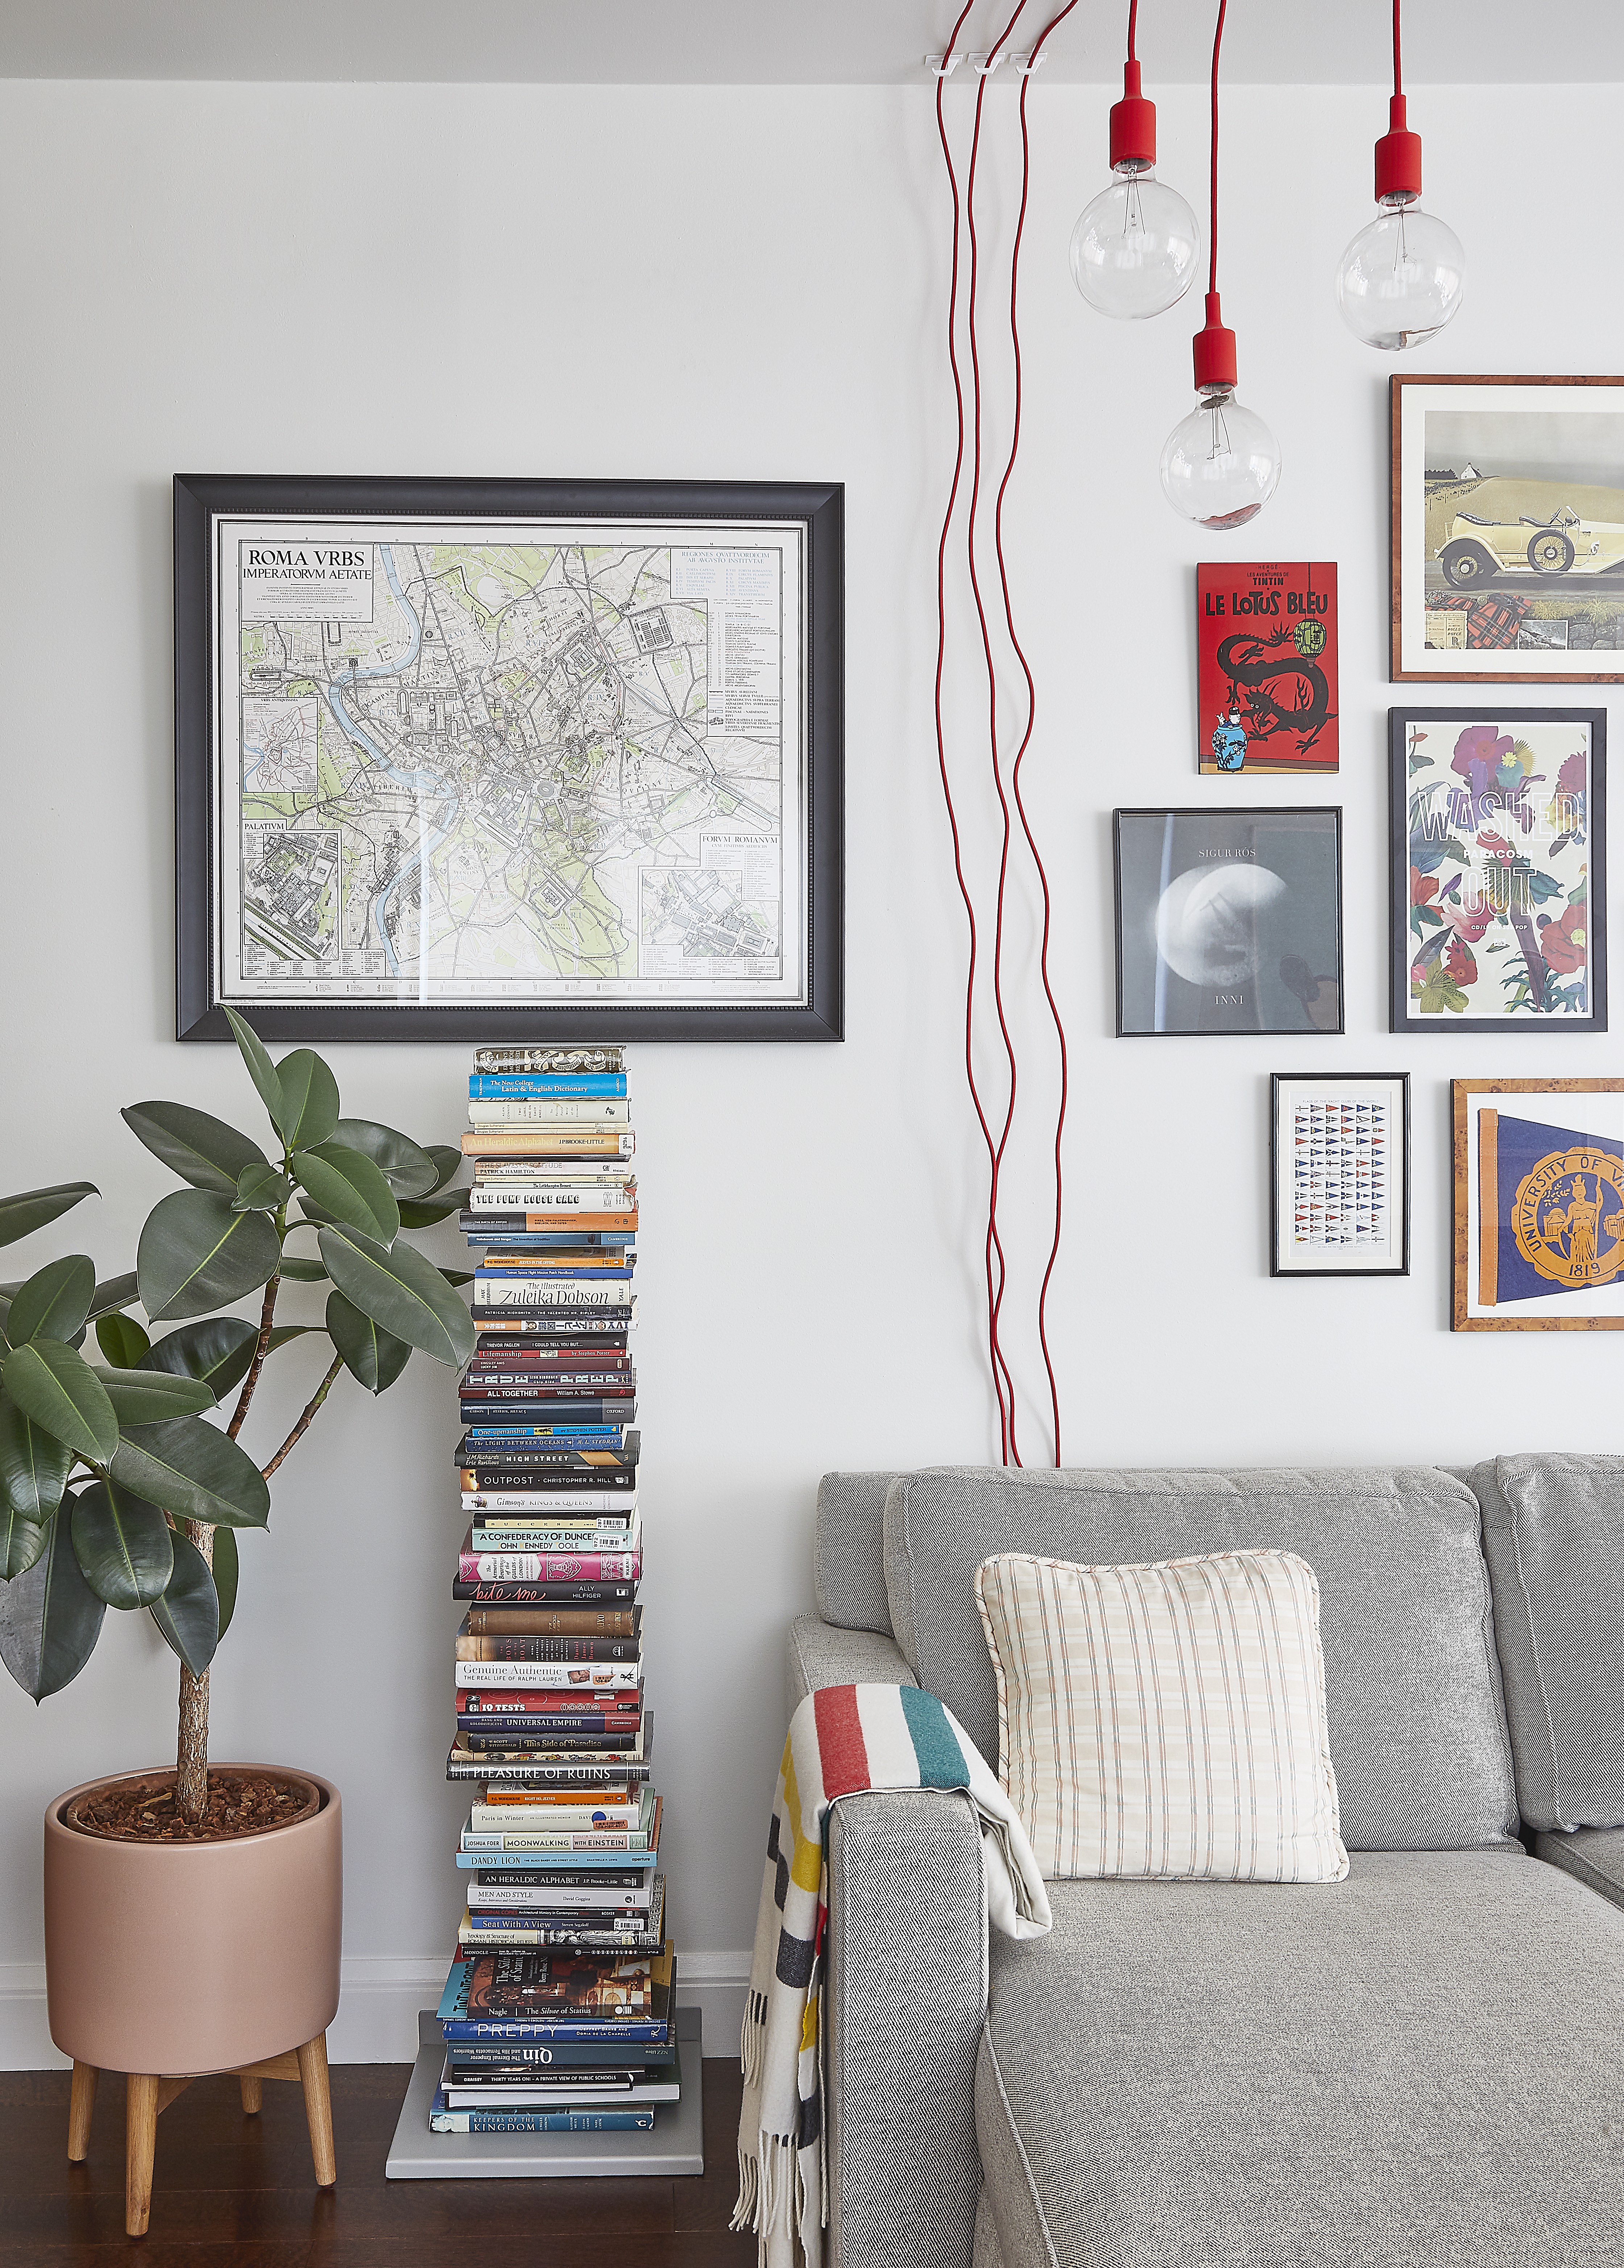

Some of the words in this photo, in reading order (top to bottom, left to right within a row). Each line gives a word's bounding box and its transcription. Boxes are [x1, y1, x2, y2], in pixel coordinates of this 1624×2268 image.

[249, 550, 308, 565] ROMA
[314, 551, 364, 566] VRBS
[243, 569, 325, 579] IMPERATORVM
[329, 570, 372, 579] AETATE
[1206, 593, 1225, 616] LE
[1232, 591, 1281, 615] LOTUS
[1287, 592, 1328, 614] BLEU
[1417, 791, 1579, 842] WASHED
[1235, 846, 1256, 857] RÓS
[1463, 848, 1533, 859] PARACOSM
[1461, 867, 1537, 917] OUT
[1215, 995, 1243, 1005] INNI
[477, 1194, 494, 1204] THE
[497, 1194, 521, 1204] PUMP
[524, 1195, 552, 1204] HOUSE
[556, 1195, 580, 1204] GANG
[1522, 1158, 1567, 1251] UNIVERSITY
[1581, 1156, 1602, 1170] OF
[1569, 1263, 1600, 1277] 1819
[499, 1290, 553, 1305] Zuleika
[556, 1291, 609, 1304] Dobson
[497, 1497, 525, 1507] Gimson's
[469, 1582, 511, 1600] bite
[511, 1587, 546, 1601] me
[463, 1664, 508, 1675] Genuine
[511, 1664, 562, 1675] Authentic
[473, 1767, 540, 1779] PLEASURE
[545, 1768, 564, 1779] OF
[568, 1768, 611, 1779] RUINS
[472, 1856, 497, 1865] DANDY
[502, 1856, 521, 1865] LION
[477, 2024, 559, 2037] PREPPY
[523, 2047, 552, 2064] Qin
